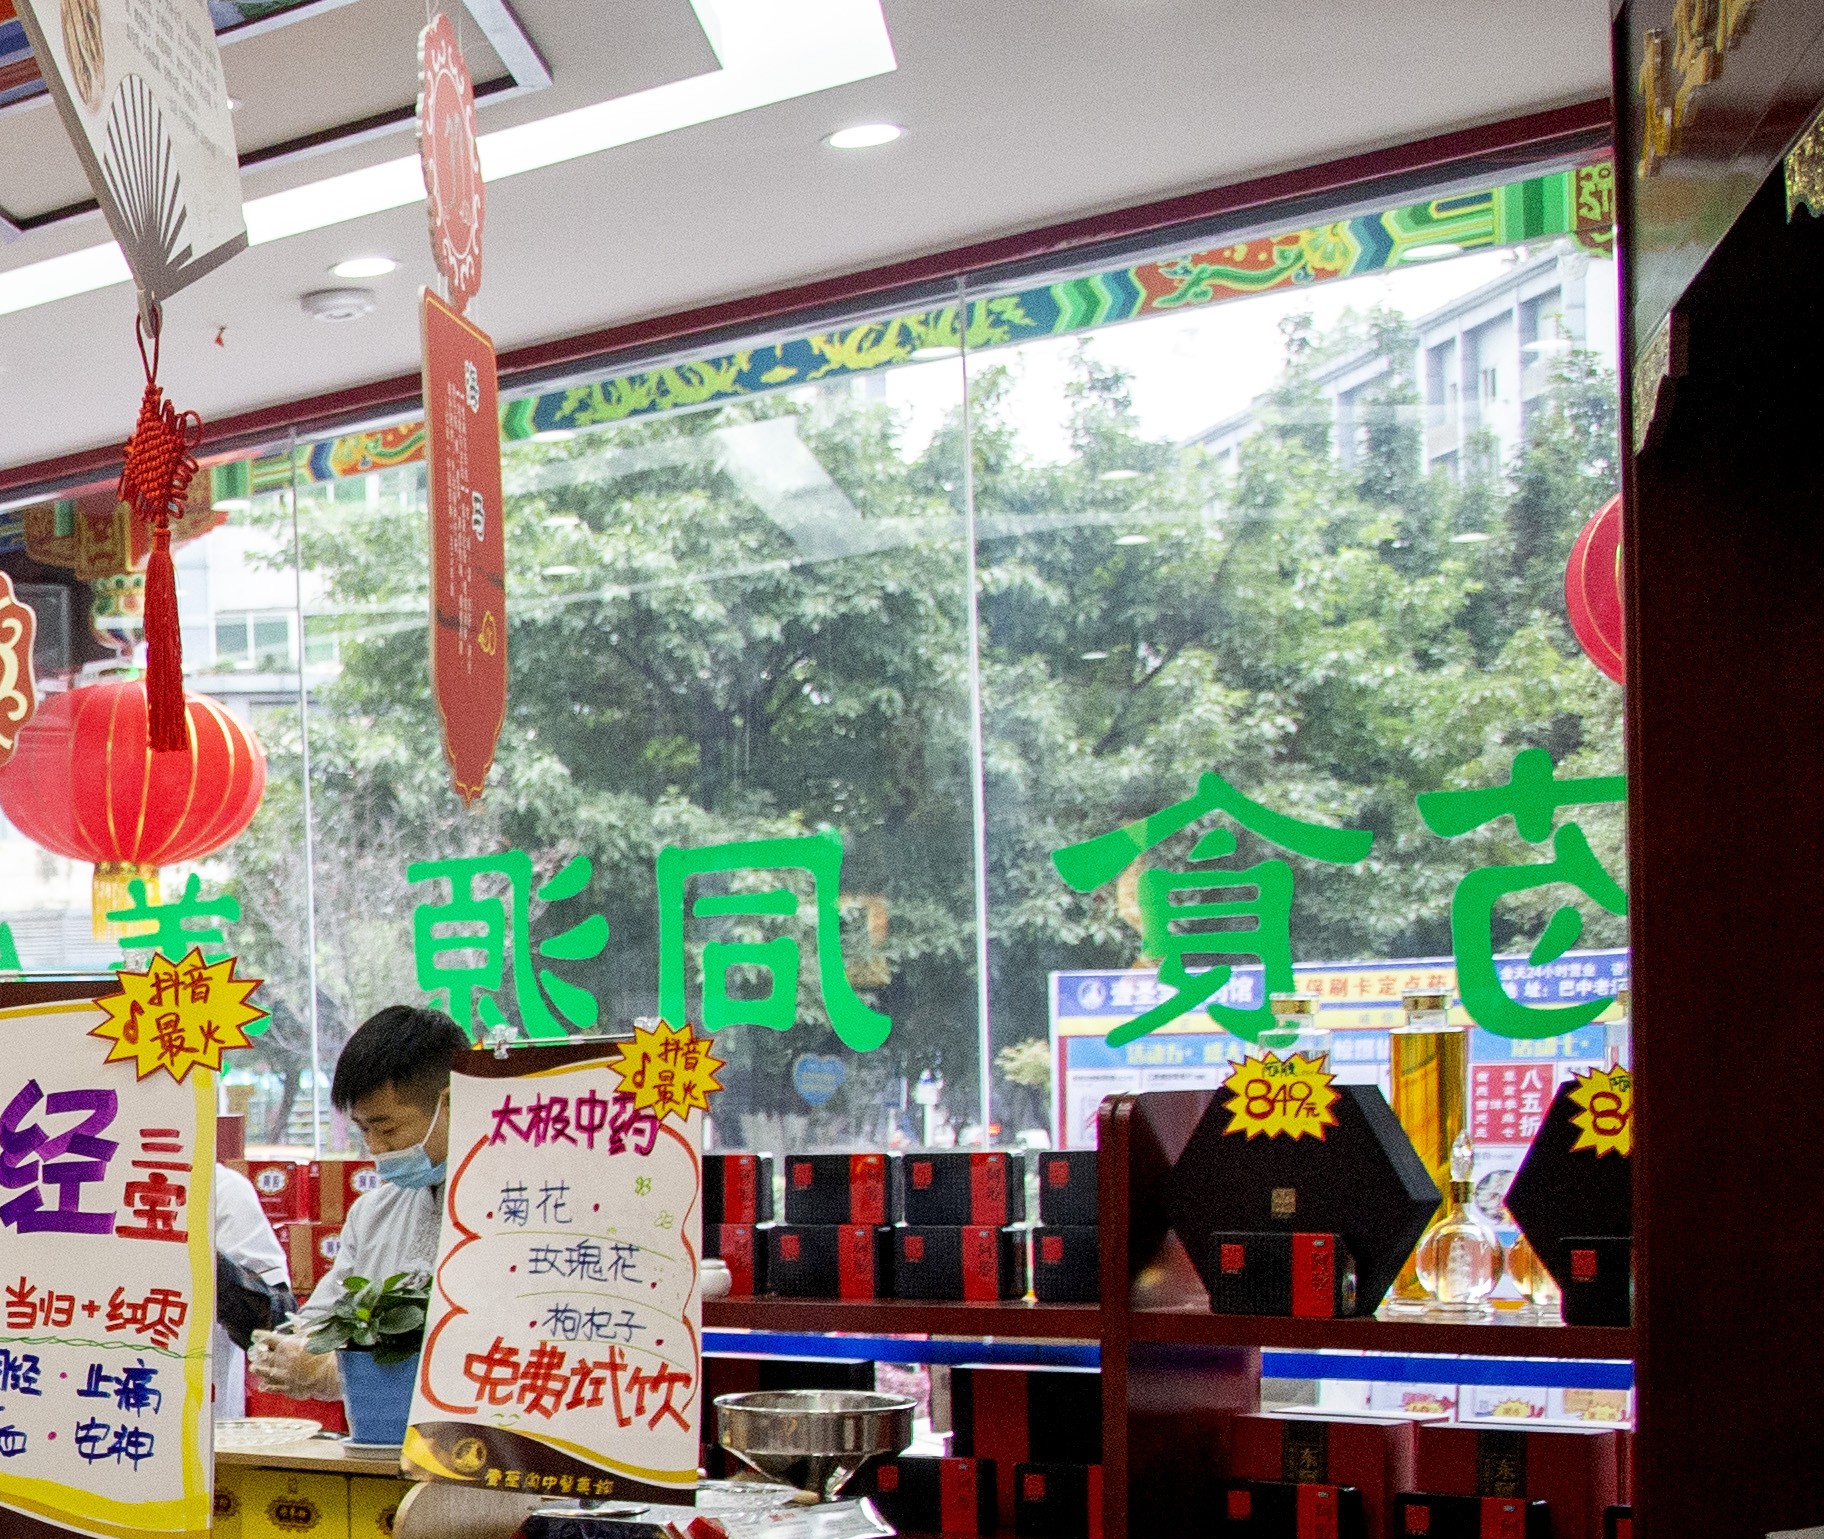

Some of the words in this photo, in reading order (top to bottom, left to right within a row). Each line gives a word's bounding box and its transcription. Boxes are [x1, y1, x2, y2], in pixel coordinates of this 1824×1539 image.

[149, 967, 211, 1007] 抖音
[151, 1012, 226, 1060] 最火
[658, 1037, 700, 1071] 抖音
[653, 1069, 697, 1107] 最火
[1517, 1067, 1543, 1140] 八五折
[116, 1128, 193, 1244] 三宝
[497, 1180, 573, 1228] 菊花
[528, 1239, 643, 1284] 玫瑰花
[541, 1302, 647, 1344] 枸杞子
[463, 1337, 693, 1434] 免费试饮
